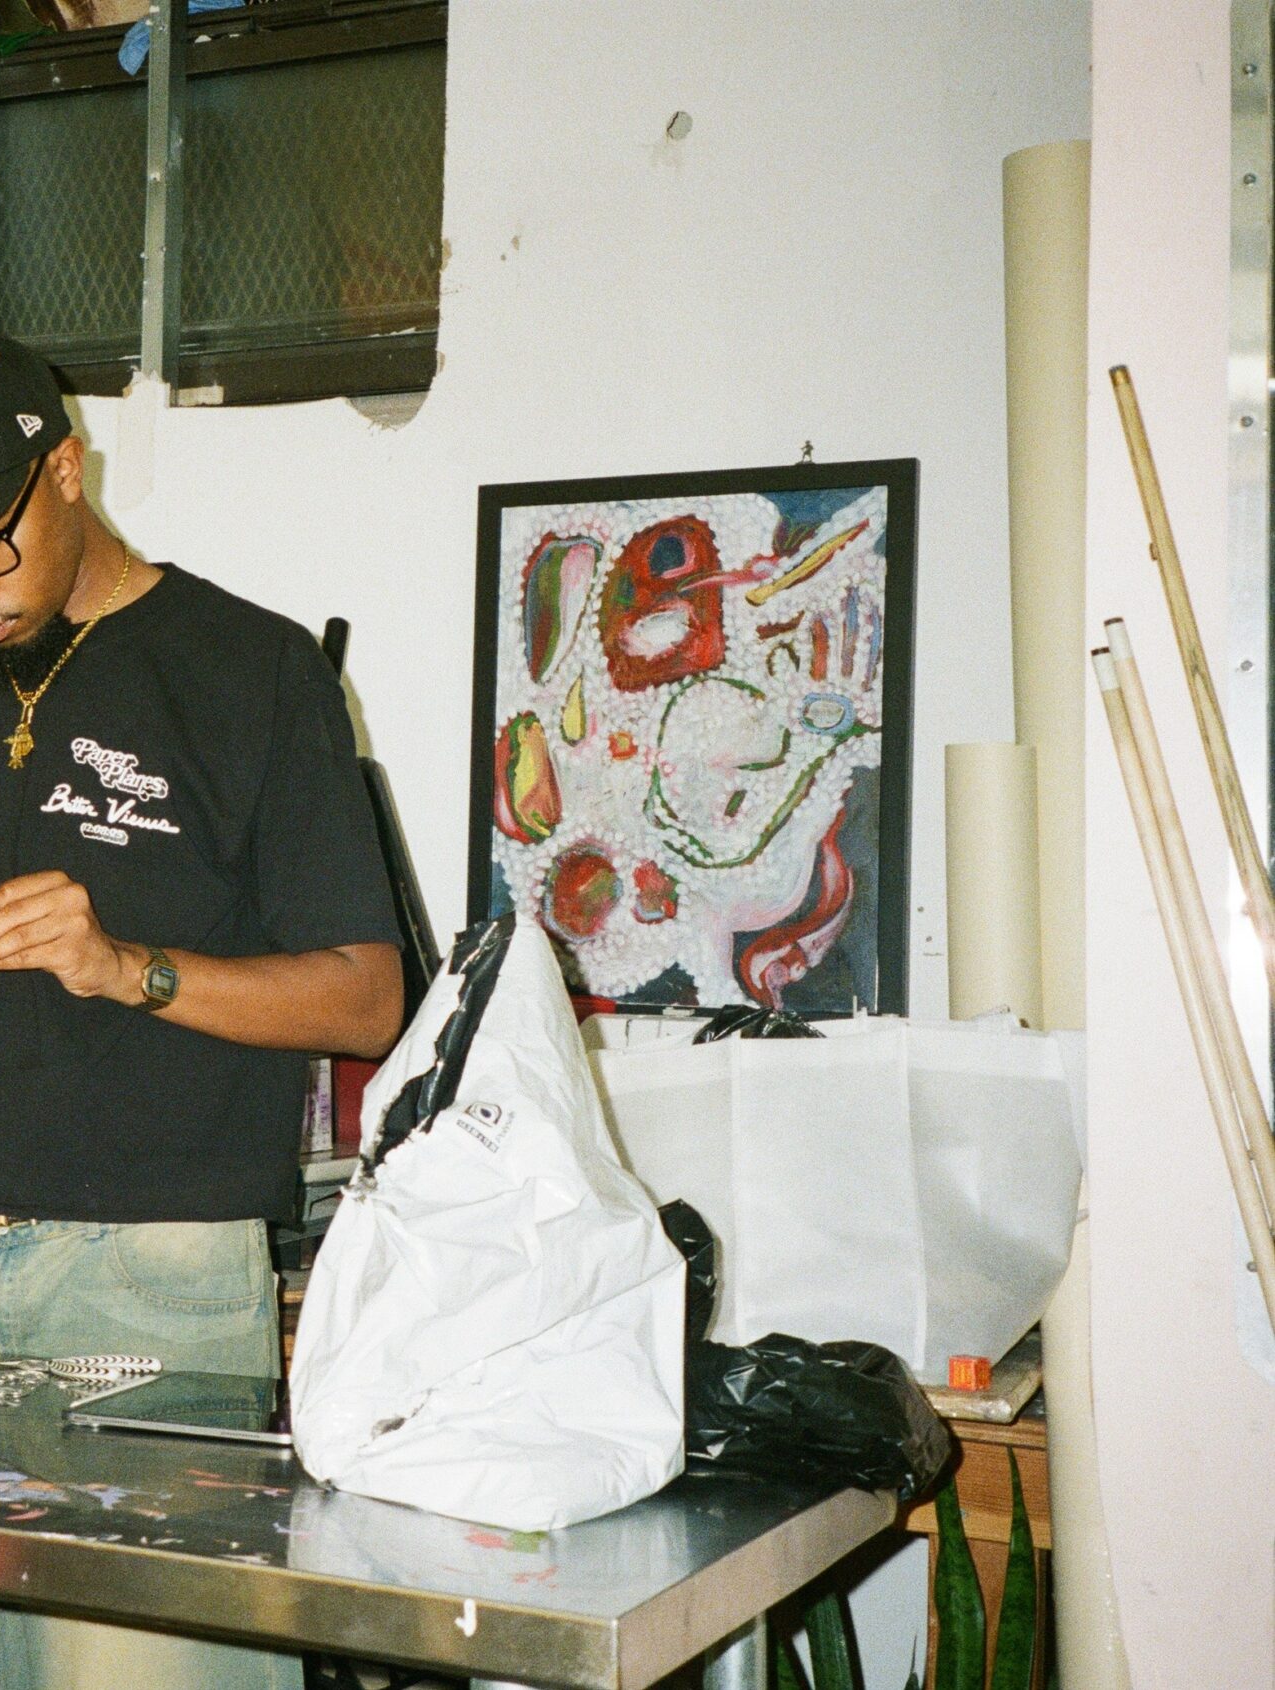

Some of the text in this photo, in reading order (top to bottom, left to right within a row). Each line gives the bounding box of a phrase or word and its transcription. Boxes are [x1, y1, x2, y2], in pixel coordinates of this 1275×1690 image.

[71, 737, 139, 770] Paper
[100, 763, 169, 801] Planes
[40, 783, 181, 834] Better Views
